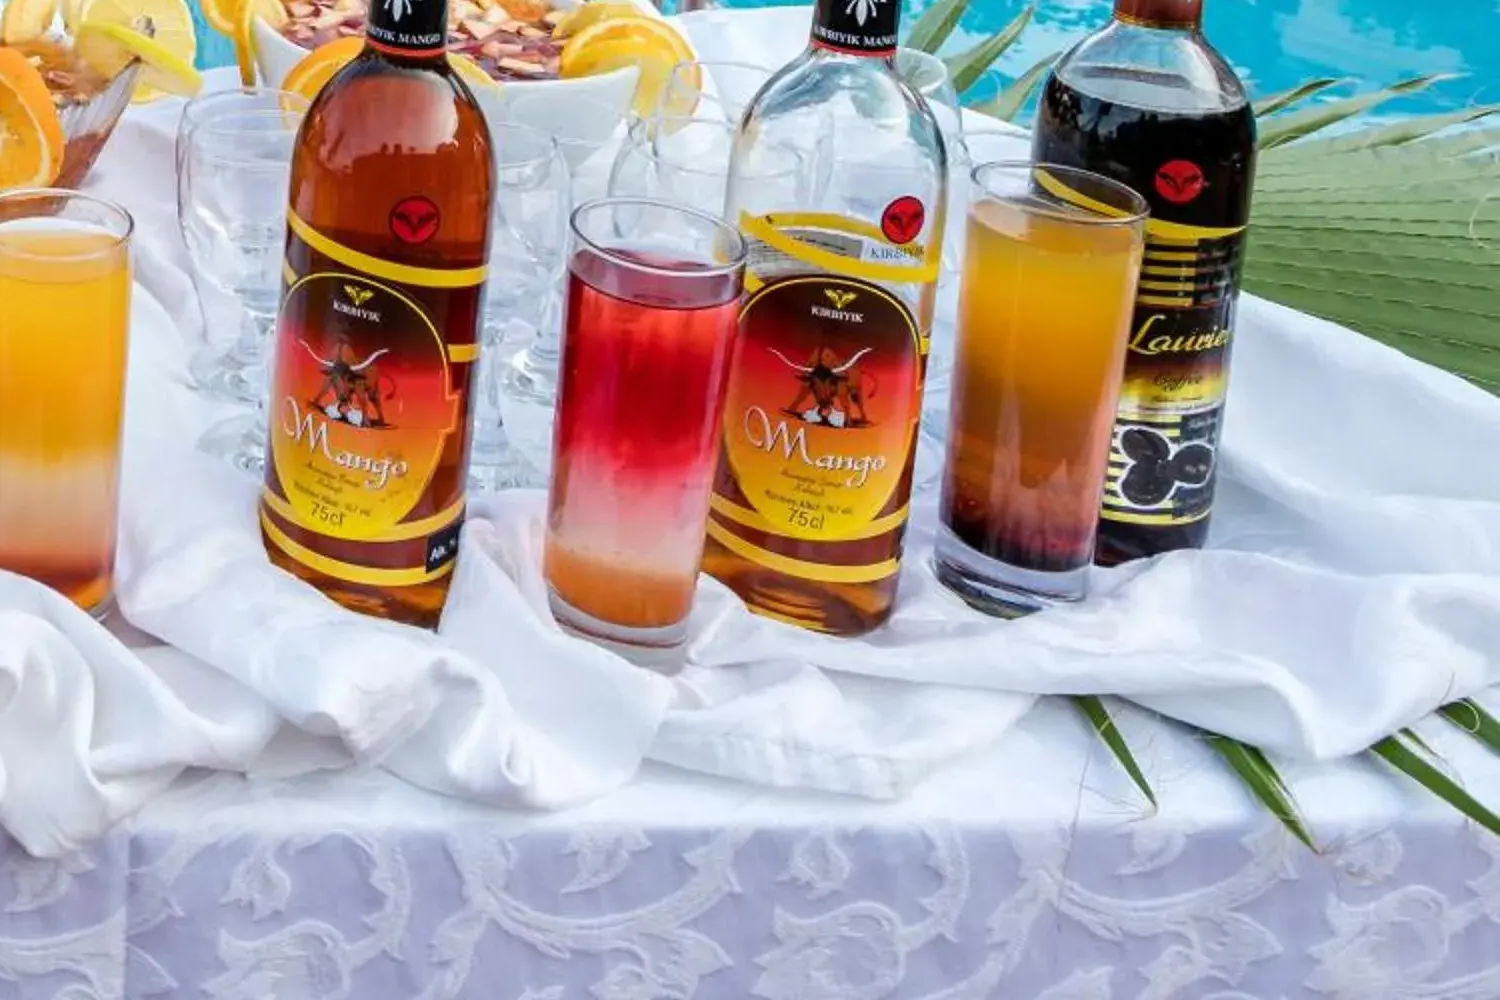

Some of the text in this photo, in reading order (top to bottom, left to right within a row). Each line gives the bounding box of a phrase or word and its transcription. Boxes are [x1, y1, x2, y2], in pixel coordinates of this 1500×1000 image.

[1127, 314, 1234, 355] Laurie
[282, 396, 408, 490] Mango
[744, 405, 887, 488] Mango
